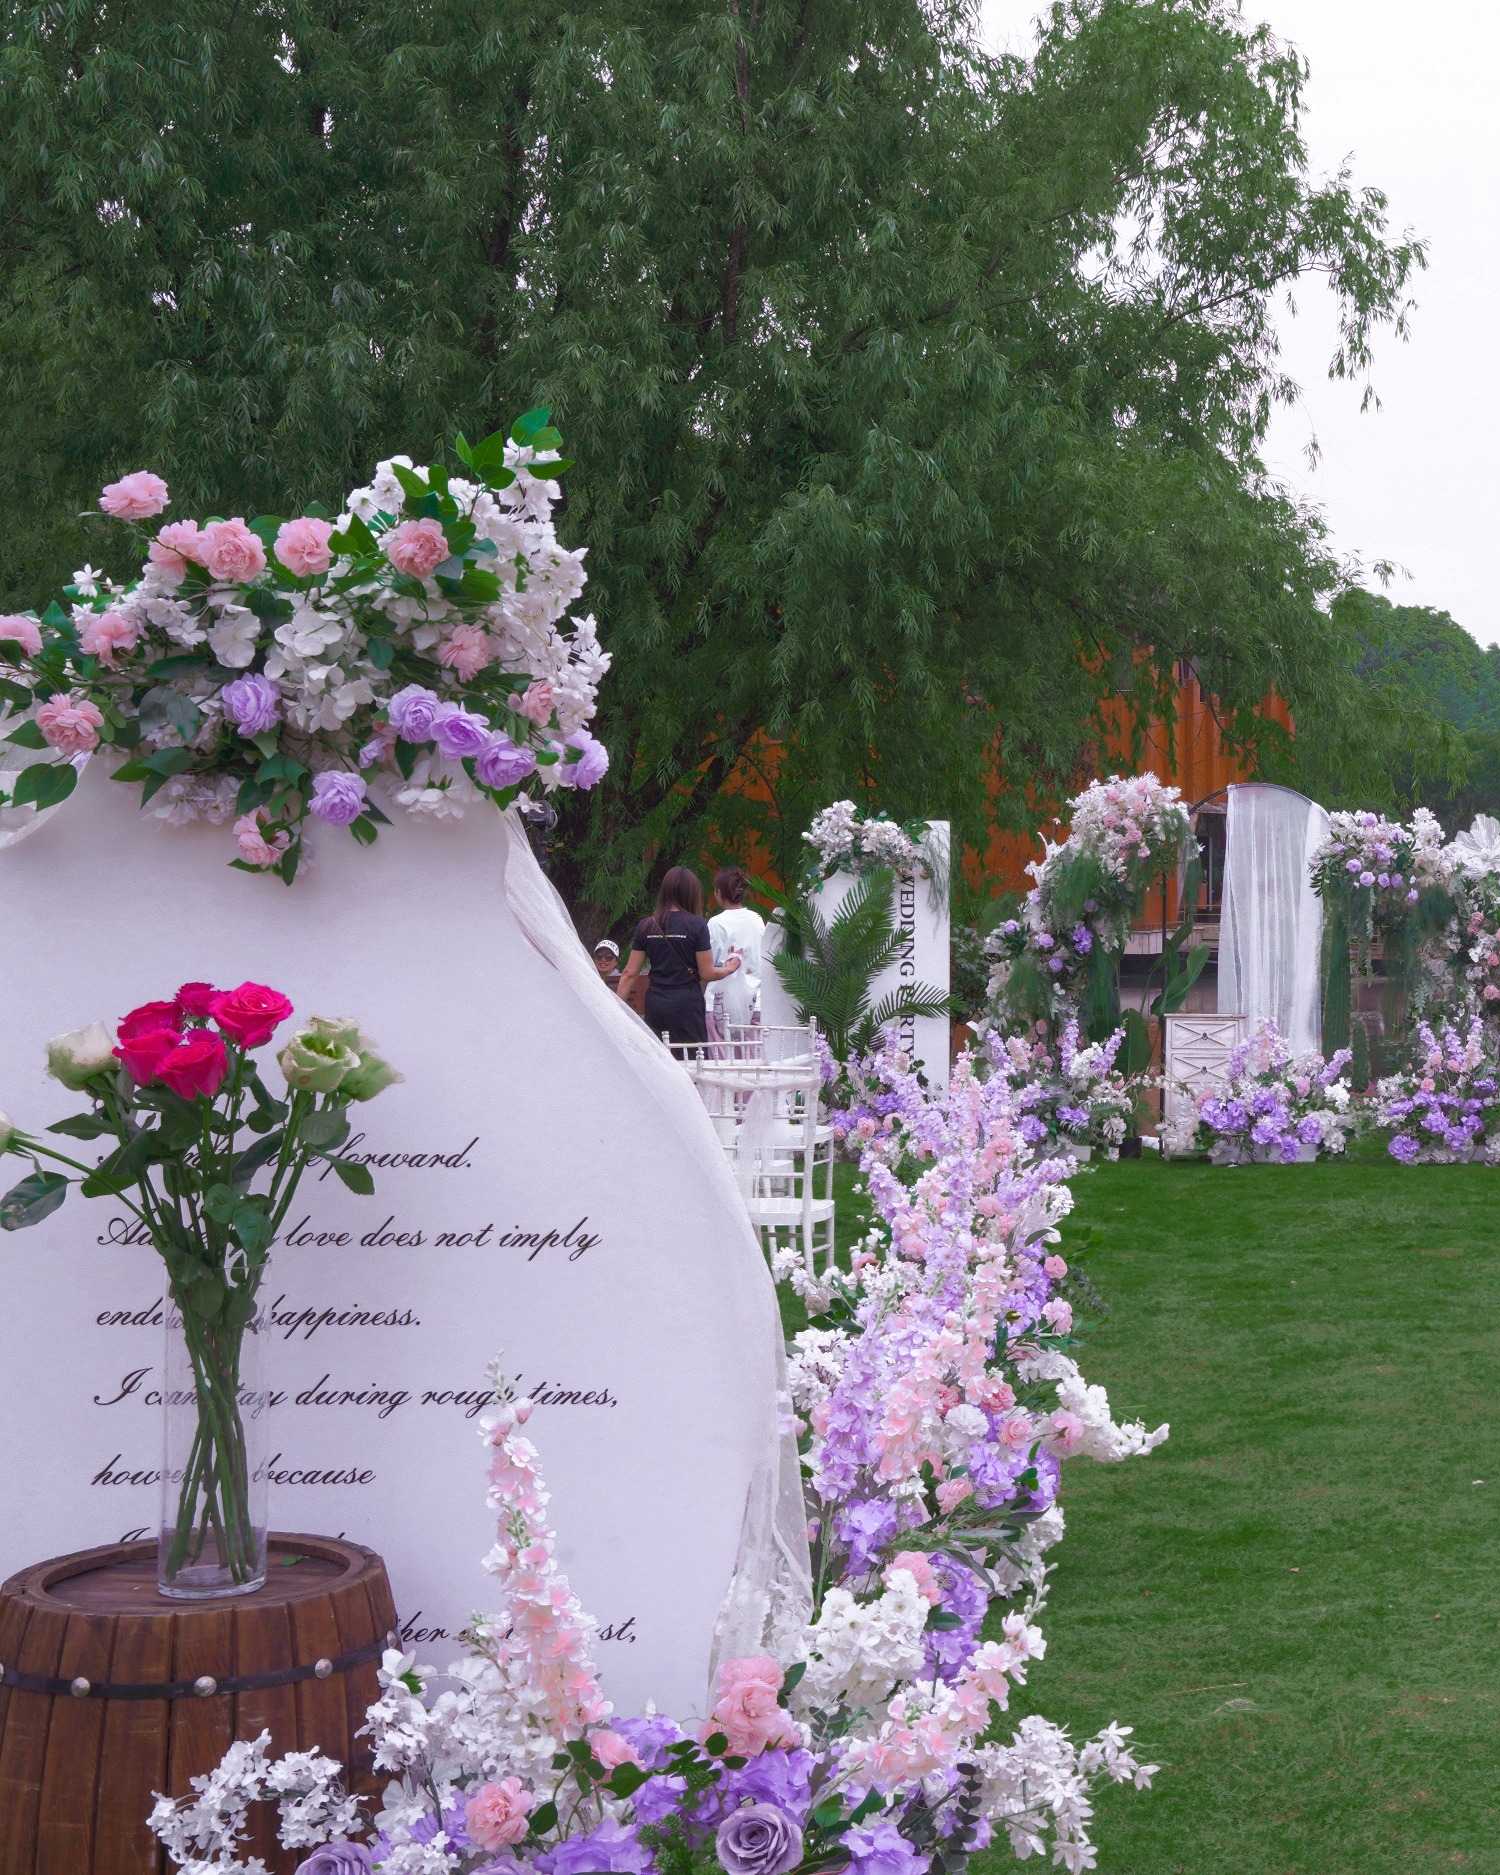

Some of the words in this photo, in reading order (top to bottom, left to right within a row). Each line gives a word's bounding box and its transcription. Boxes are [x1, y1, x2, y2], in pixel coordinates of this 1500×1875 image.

[285, 1215, 354, 1248] love
[359, 1215, 428, 1248] does
[434, 1223, 495, 1248] not
[499, 1216, 603, 1262] imply
[93, 1366, 154, 1406] I
[294, 1373, 412, 1419] during
[527, 1381, 618, 1408] times,
